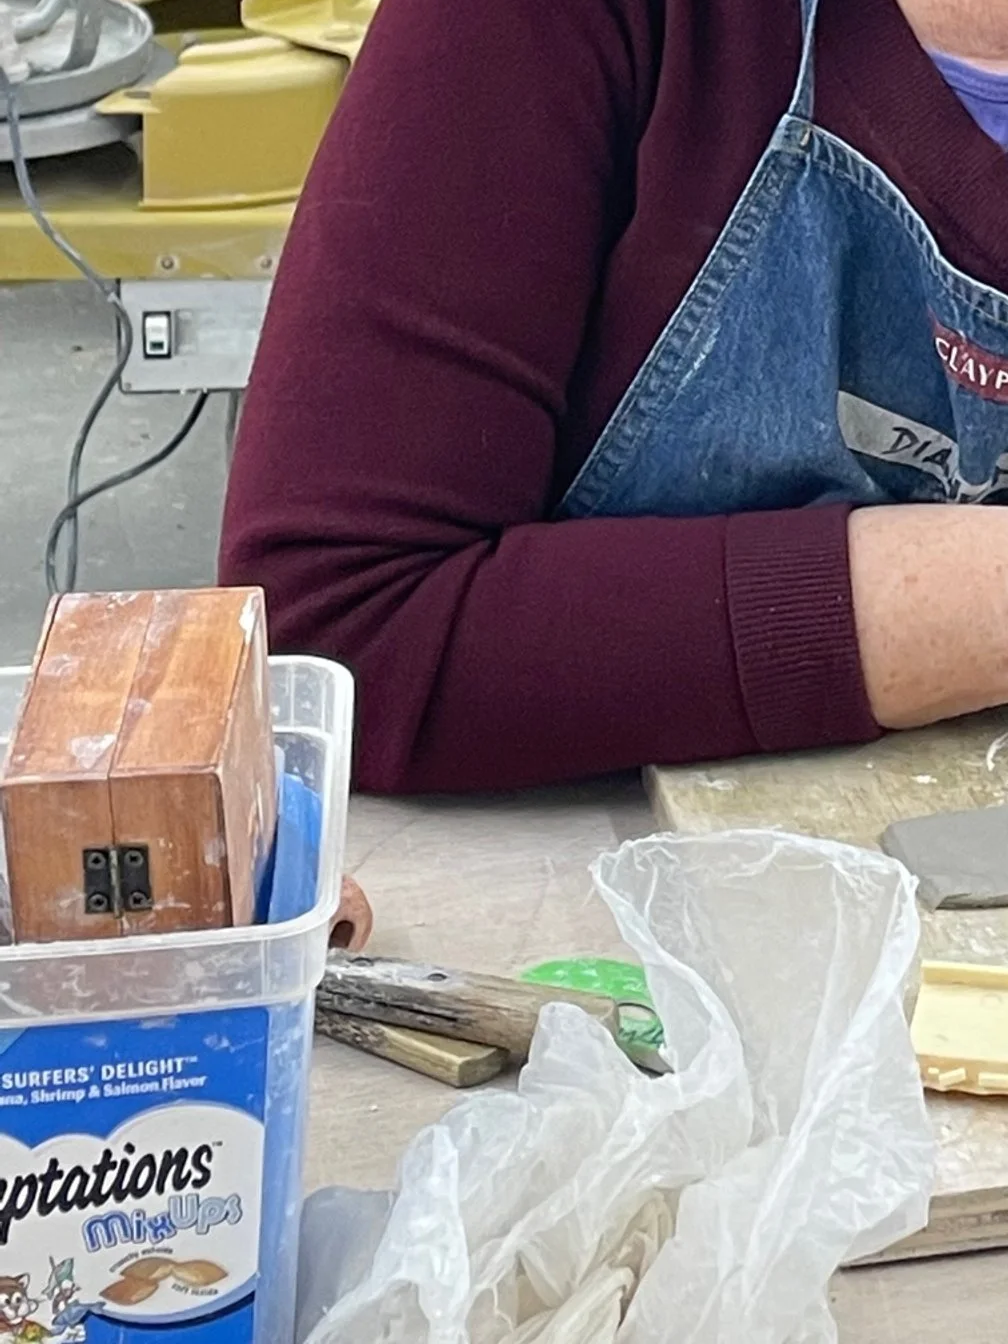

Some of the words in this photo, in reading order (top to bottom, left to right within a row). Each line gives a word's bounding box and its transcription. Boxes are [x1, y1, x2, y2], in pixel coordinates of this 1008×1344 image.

[2, 1065, 95, 1090] SURFERS'
[31, 1085, 86, 1104] Shrimp
[88, 1084, 101, 1099] &
[103, 1079, 159, 1098] Salmon
[161, 1074, 208, 1093] Flavor
